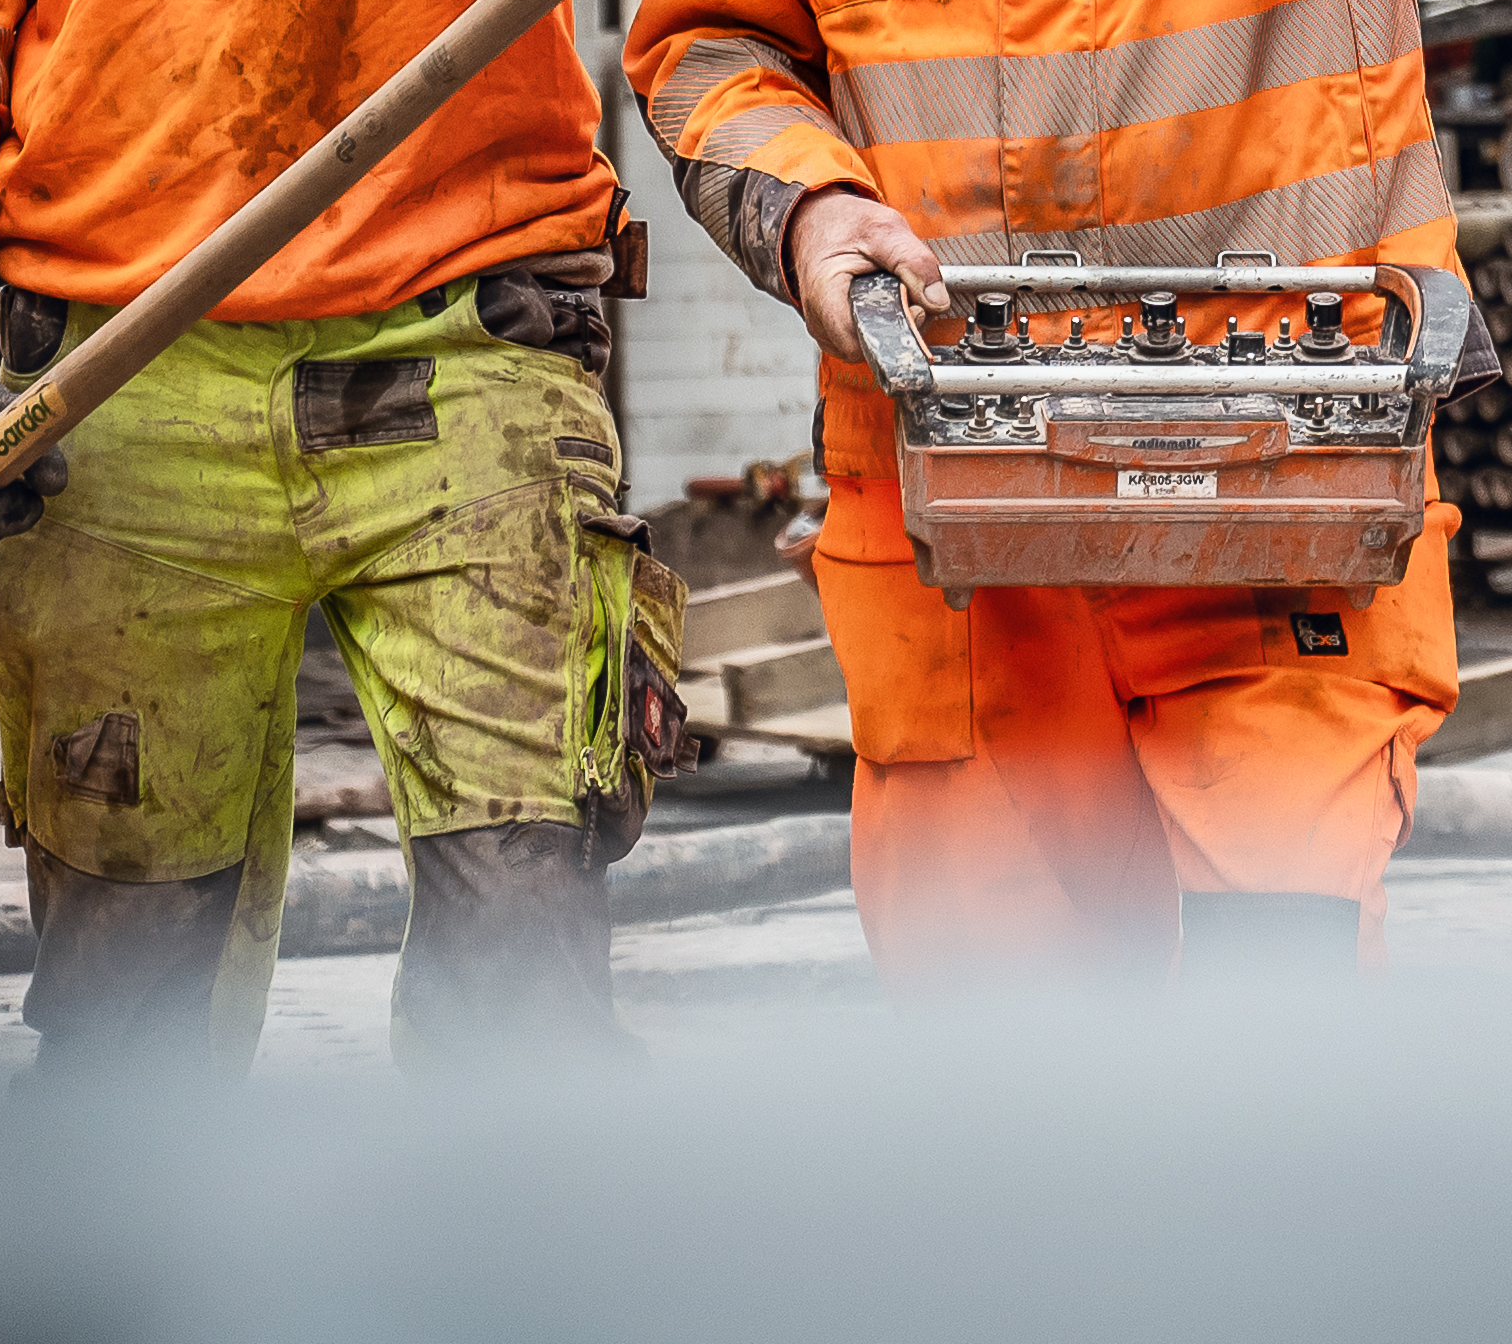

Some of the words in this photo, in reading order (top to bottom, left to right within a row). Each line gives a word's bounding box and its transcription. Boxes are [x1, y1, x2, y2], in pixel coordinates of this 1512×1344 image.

[1128, 474, 1146, 486] KR
[1150, 474, 1205, 486] 805-3GW
[1309, 635, 1341, 646] CXS
